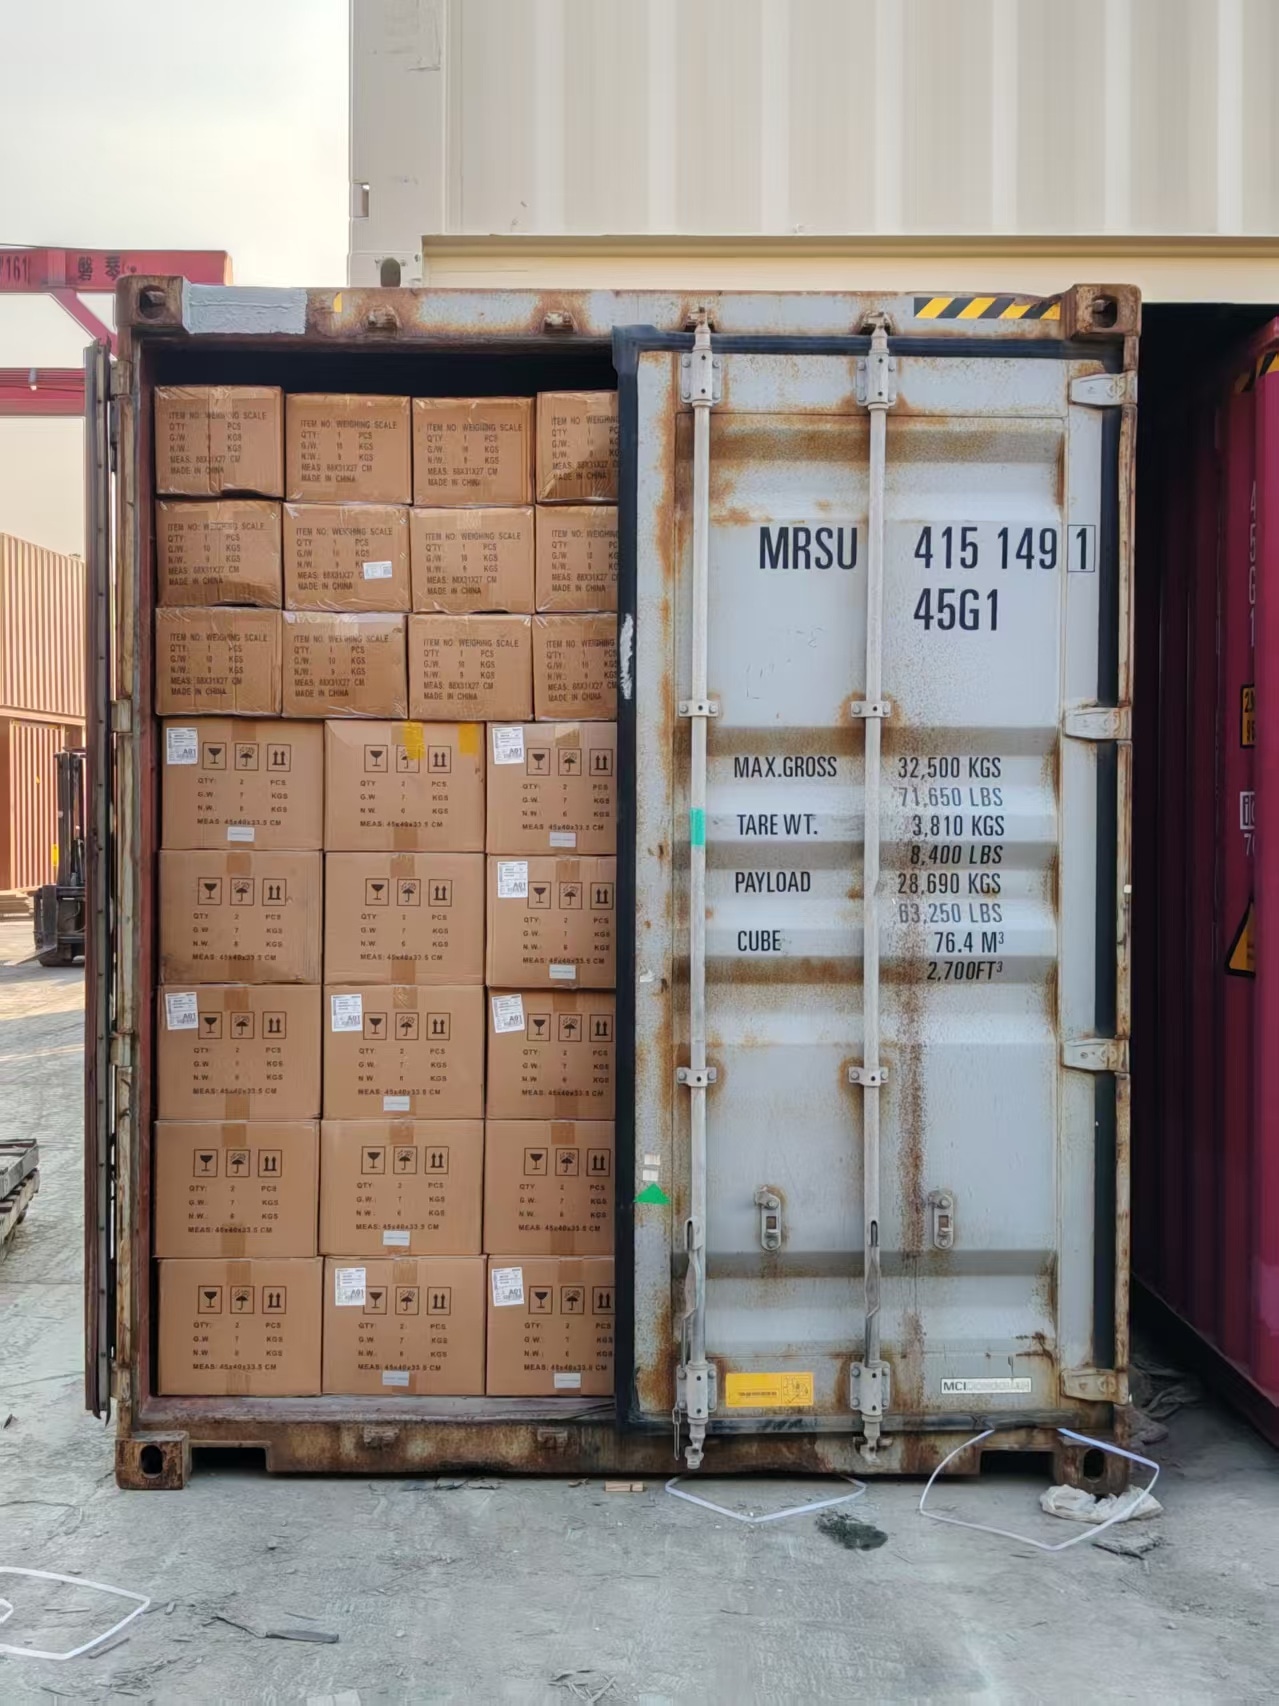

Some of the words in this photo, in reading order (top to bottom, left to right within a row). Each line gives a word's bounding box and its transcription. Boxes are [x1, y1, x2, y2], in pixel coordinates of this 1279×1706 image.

[243, 412, 266, 420] SCALE
[374, 421, 397, 429] SCALE
[206, 467, 224, 475] CHINA
[302, 474, 320, 482] MADE
[587, 472, 607, 480] CHINA
[242, 522, 265, 530] SCALE
[499, 532, 520, 540] SCALE
[759, 526, 857, 570] MRSU
[914, 526, 978, 569] 415
[997, 526, 1058, 570] 149
[1075, 528, 1088, 569] 1
[203, 578, 223, 586] CHINA
[298, 582, 317, 590] MADE
[332, 582, 352, 590] CHINA
[427, 587, 446, 595] MADE
[913, 588, 999, 630] 45G1
[245, 634, 267, 642] SCALE
[366, 635, 388, 643] SCALE
[582, 693, 601, 701] CHINA
[734, 756, 837, 778] MAX.GROSS
[898, 756, 960, 780] 32,500
[968, 757, 1001, 778] KGS
[900, 788, 961, 809] 71,650
[970, 787, 1003, 806] LBS
[737, 815, 778, 835] TARE
[783, 814, 818, 836] WT.
[912, 815, 963, 838] 3,810
[971, 815, 1004, 836] KGS
[910, 845, 962, 867] 8,400
[969, 844, 1003, 865] LBS
[735, 872, 811, 893] PAYLOAD
[898, 873, 959, 896] 28,690
[968, 873, 1001, 894] KGS
[899, 903, 962, 925] 63,250
[970, 903, 1003, 923] LBS
[737, 931, 781, 952] CUBE
[934, 932, 974, 953] 76.4
